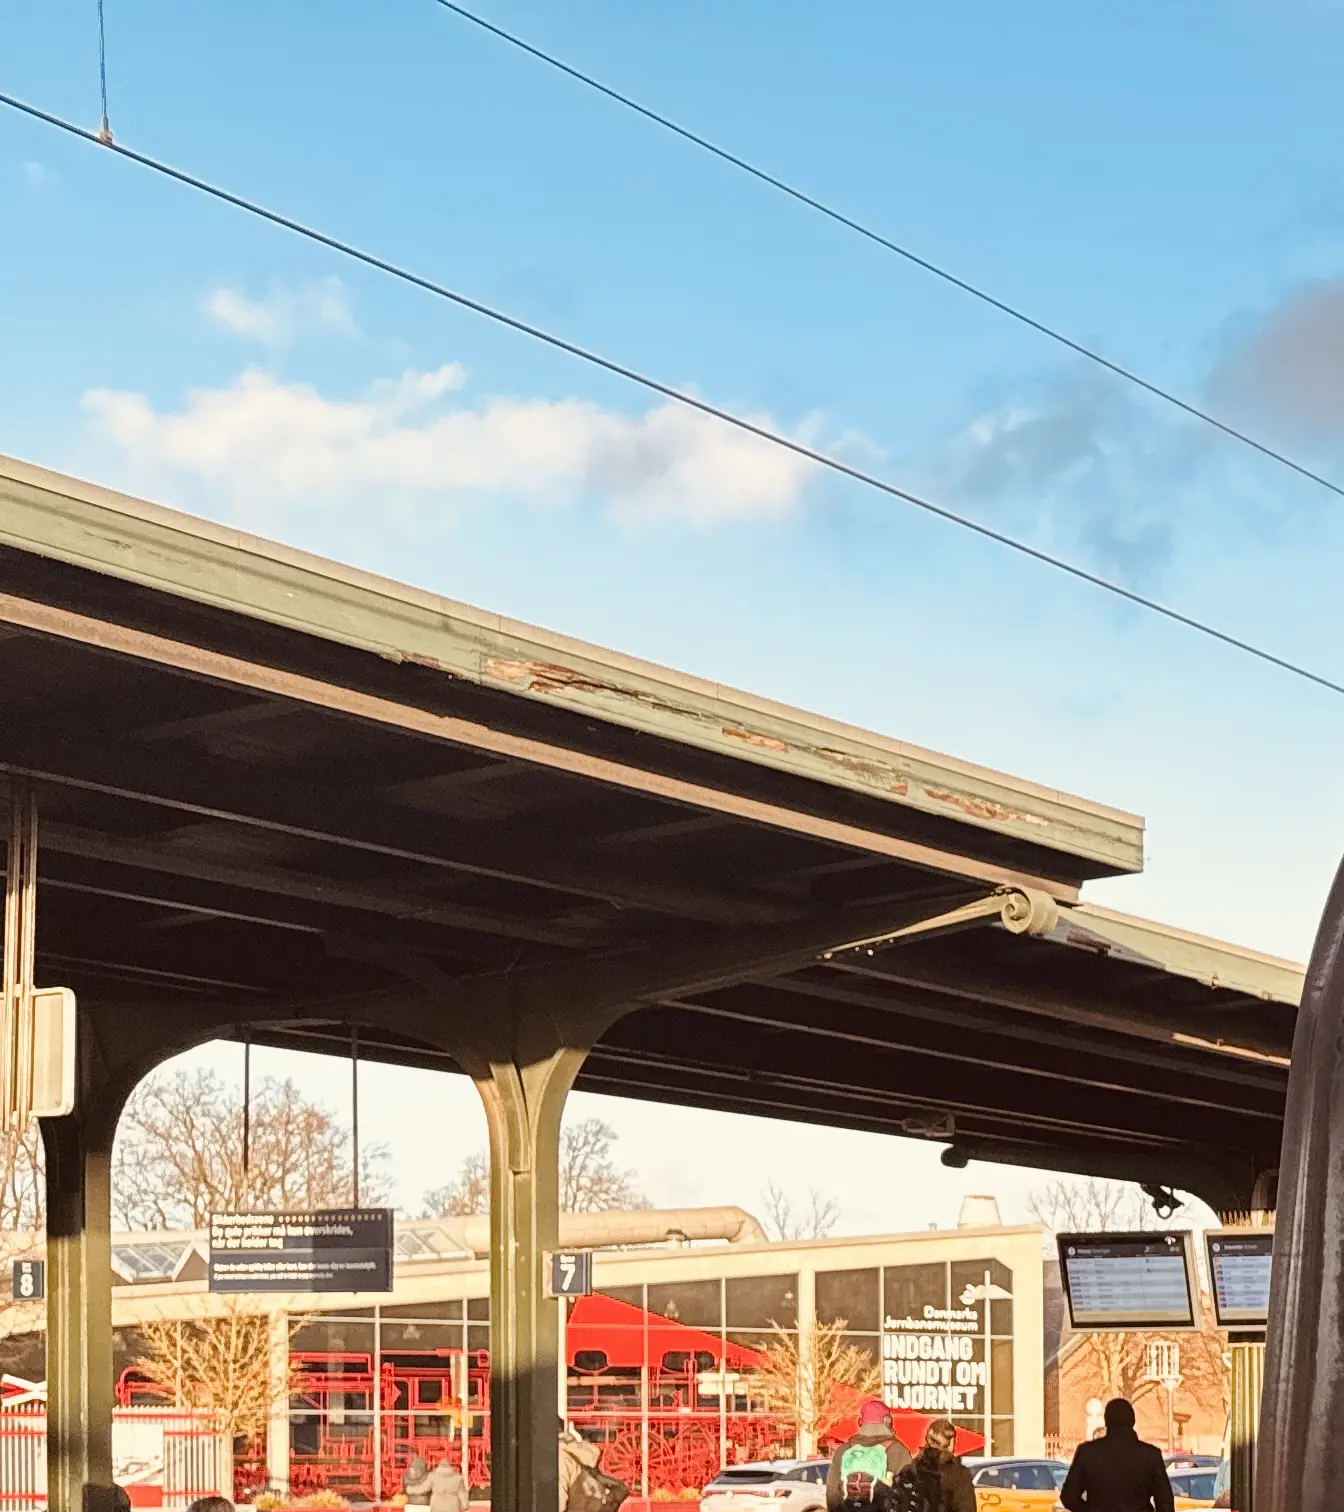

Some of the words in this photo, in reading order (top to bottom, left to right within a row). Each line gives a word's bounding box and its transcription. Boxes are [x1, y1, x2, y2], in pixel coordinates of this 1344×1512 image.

[20, 1273, 34, 1296] 8
[560, 1264, 576, 1291] 7
[884, 1315, 979, 1331] Jernbanemuseum
[923, 1305, 978, 1321] Danmarks
[883, 1334, 974, 1360] INDGANG
[883, 1360, 953, 1385] RUNDT
[955, 1361, 986, 1386] OM
[884, 1384, 978, 1410] HJØRNET
